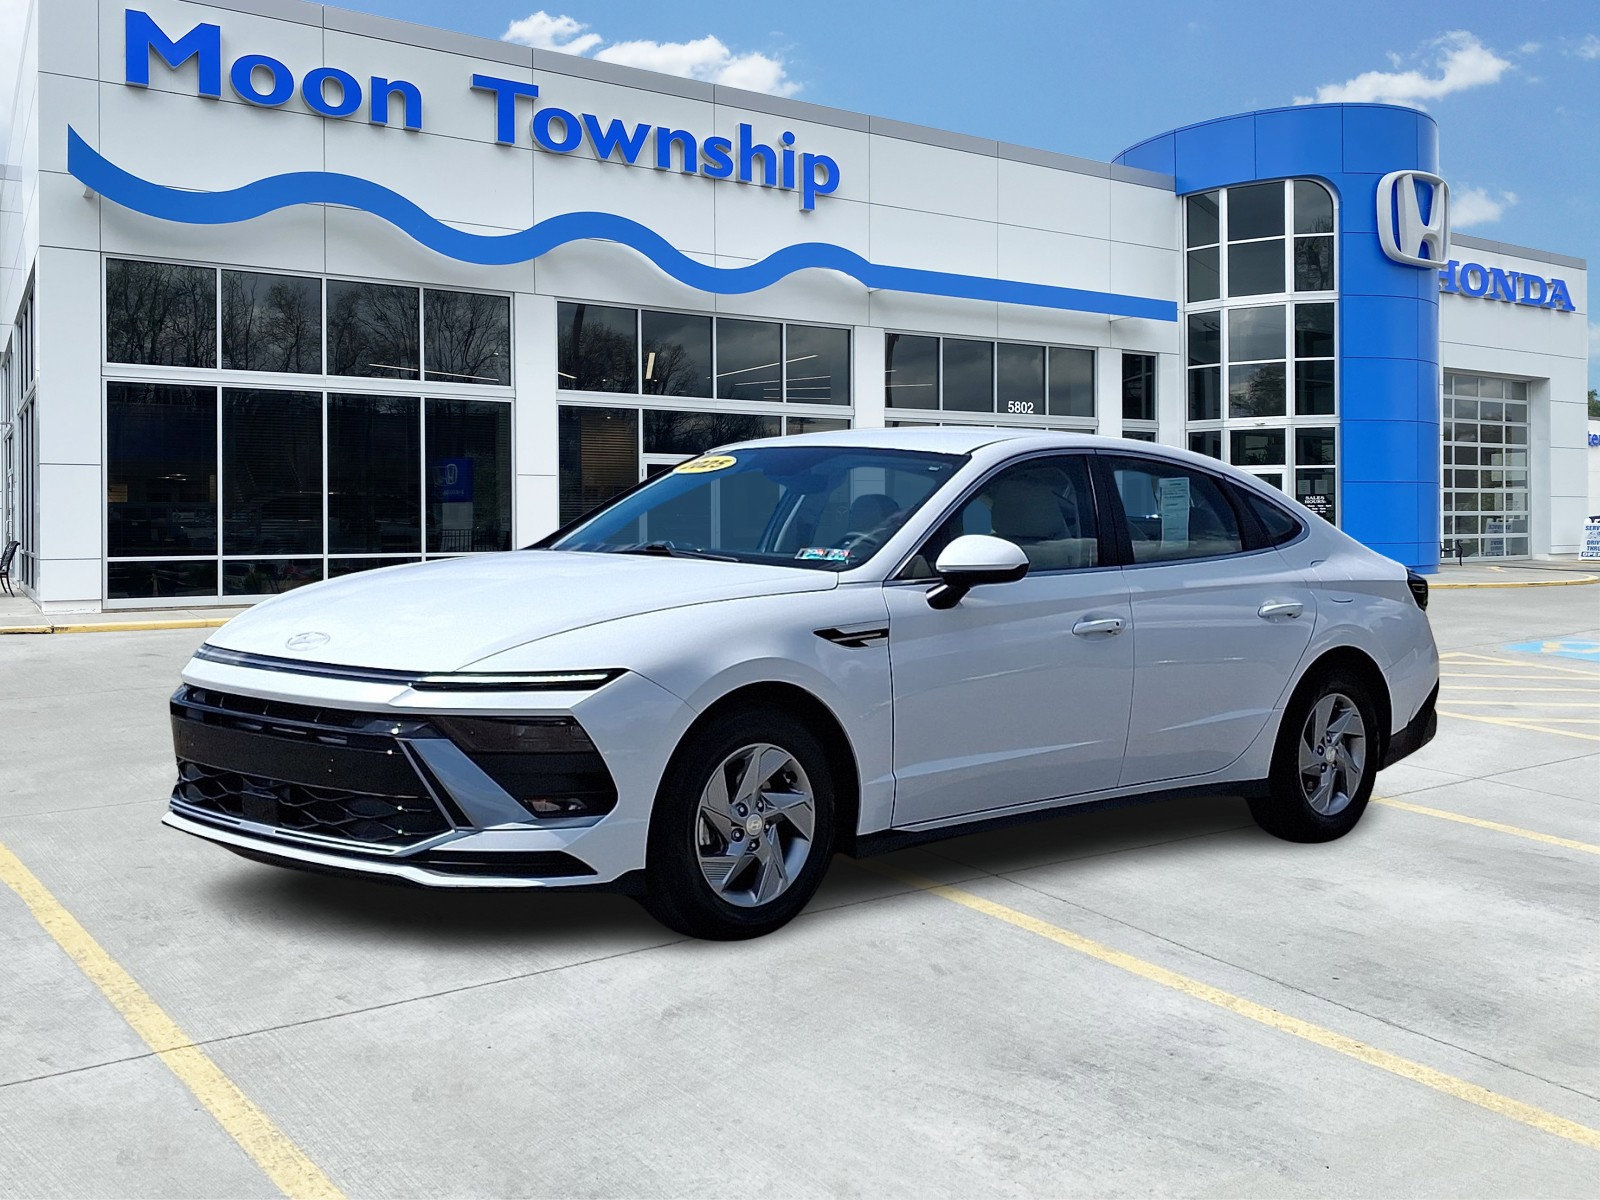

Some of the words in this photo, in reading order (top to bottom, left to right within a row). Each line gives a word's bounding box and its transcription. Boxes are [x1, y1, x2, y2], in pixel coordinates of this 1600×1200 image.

[125, 8, 423, 132] Moon
[469, 73, 841, 212] Township
[1007, 400, 1034, 414] 5802
